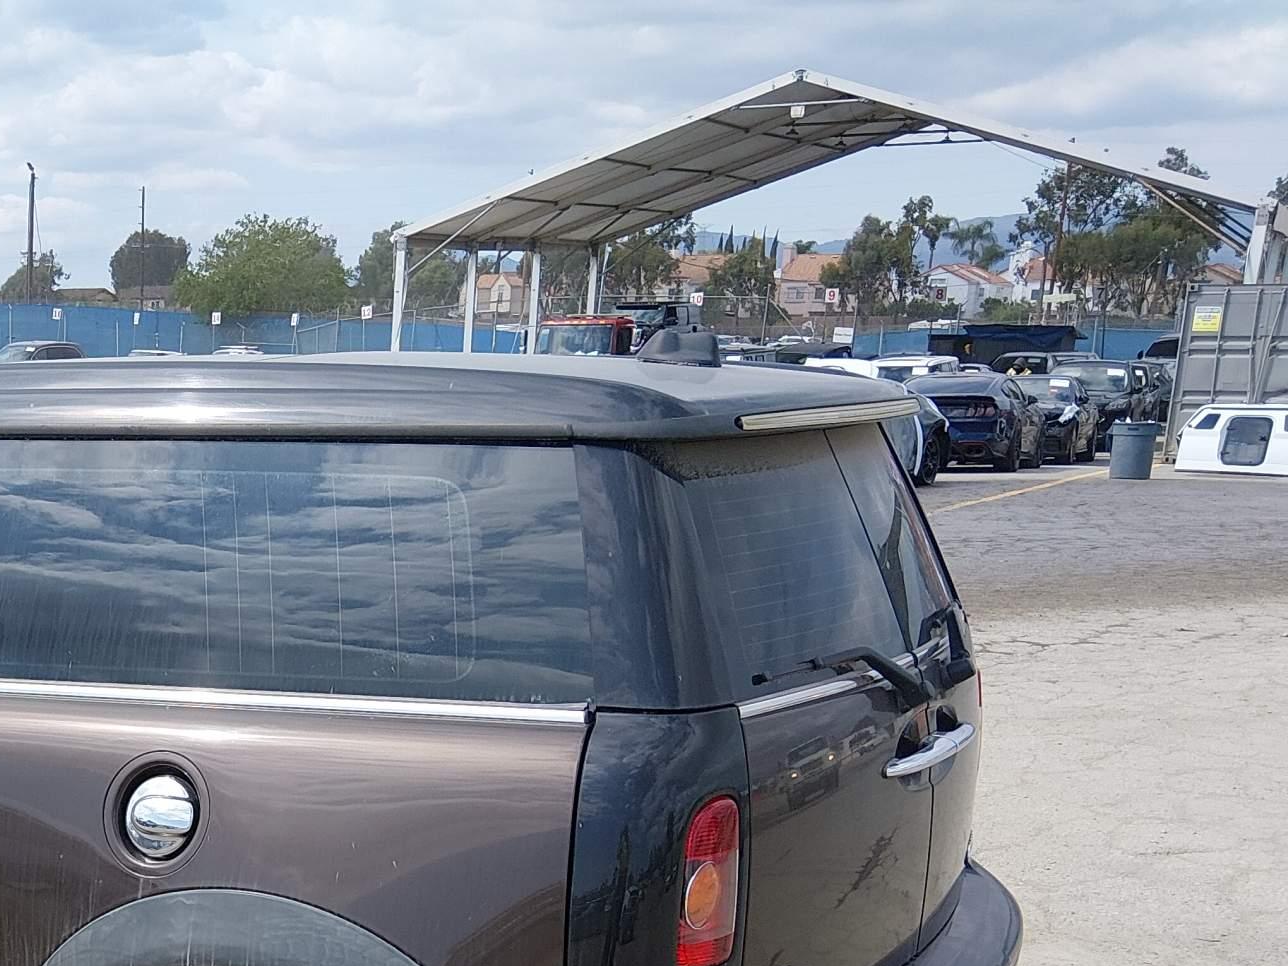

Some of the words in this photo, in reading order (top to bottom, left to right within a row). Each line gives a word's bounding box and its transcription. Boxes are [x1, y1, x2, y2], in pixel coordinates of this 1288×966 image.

[828, 290, 836, 301] 9
[935, 288, 944, 300] 8
[691, 295, 702, 304] 10
[362, 307, 371, 317] 12
